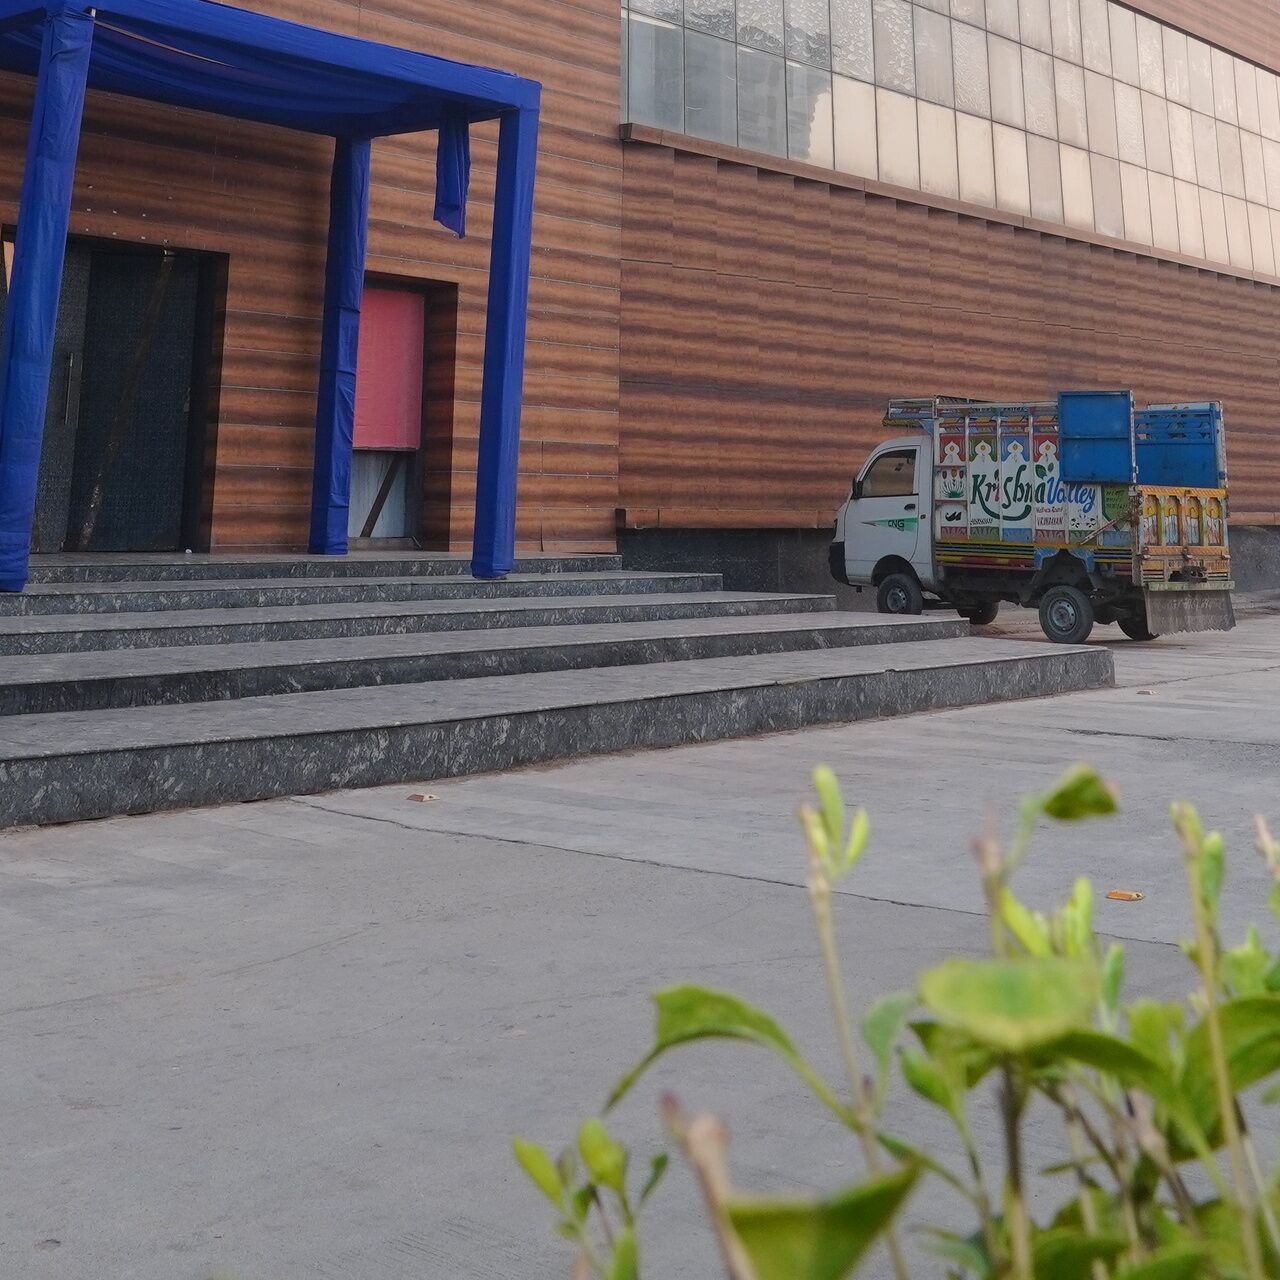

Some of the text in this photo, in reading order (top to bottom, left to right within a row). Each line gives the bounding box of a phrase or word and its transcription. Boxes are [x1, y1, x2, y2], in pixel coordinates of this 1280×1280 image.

[970, 464, 1046, 521] Krishna
[1047, 477, 1096, 513] Valley
[888, 519, 905, 531] CNG
